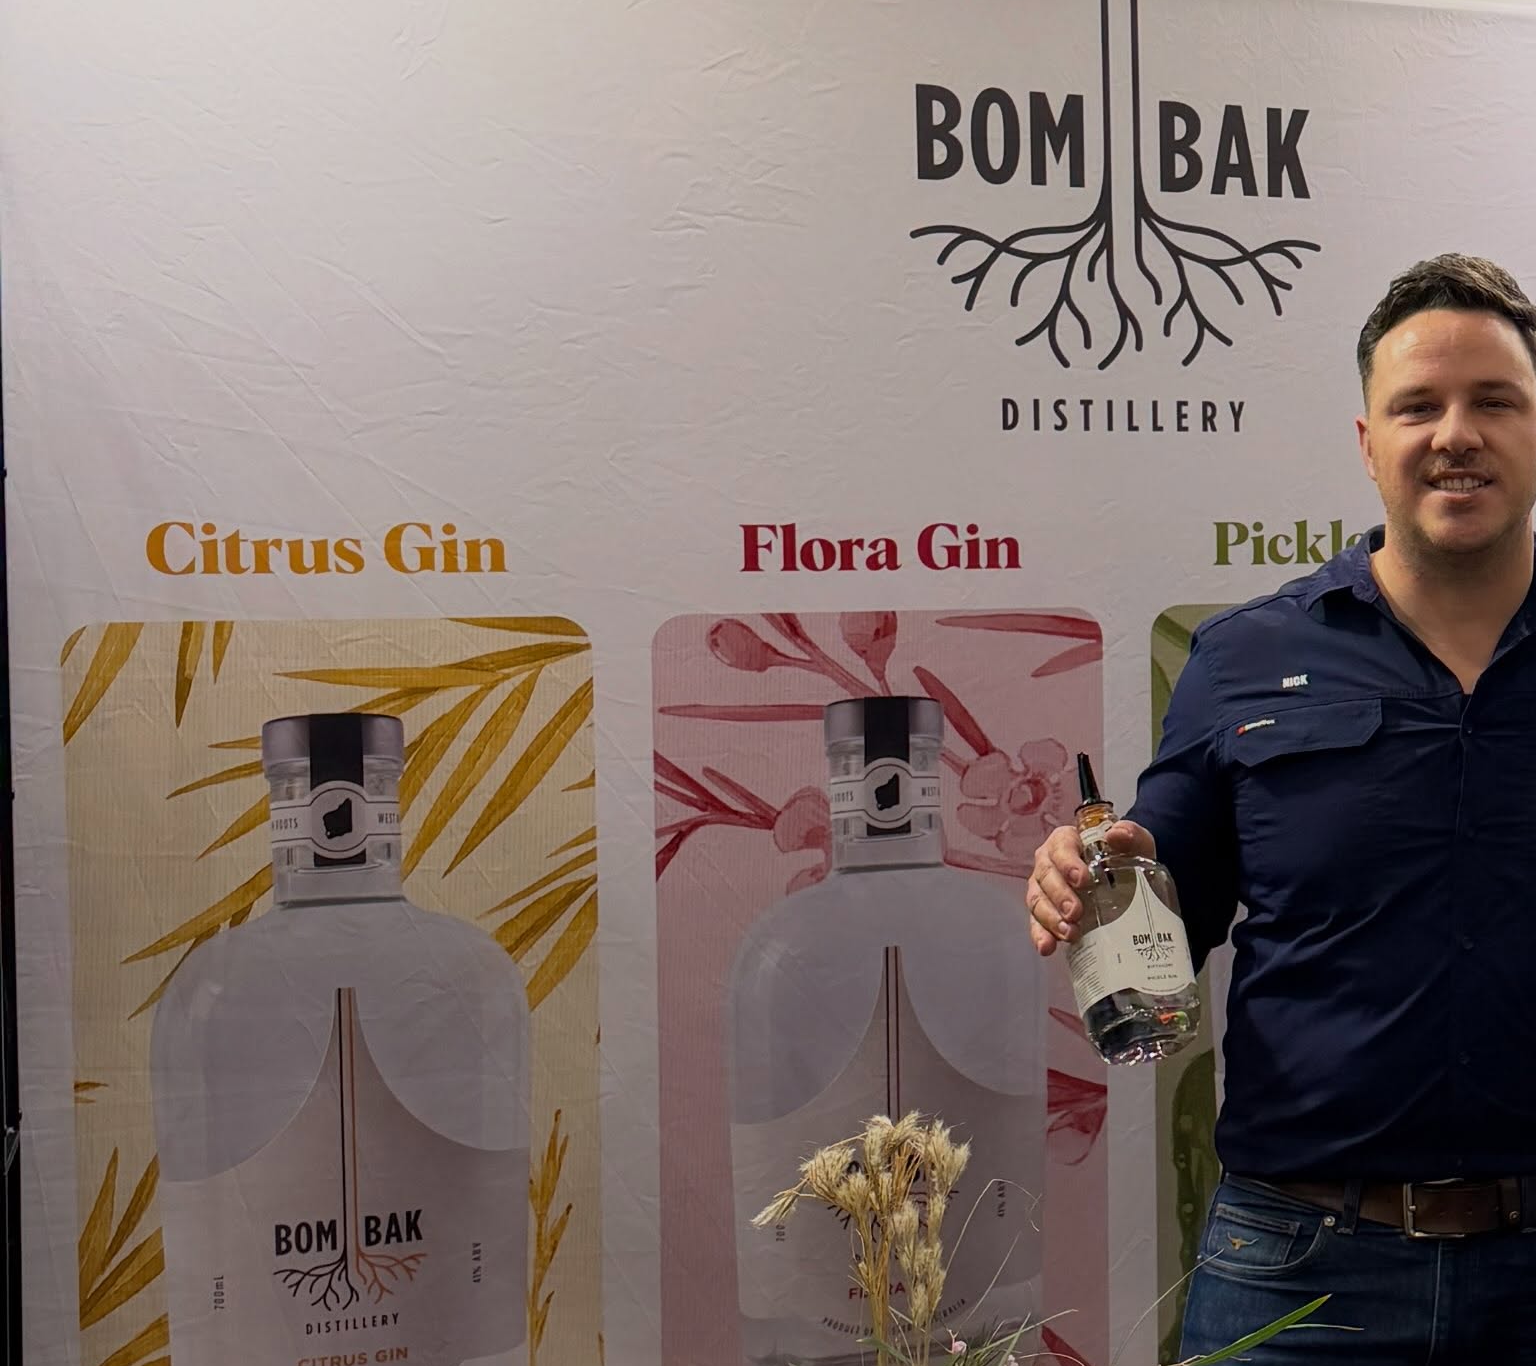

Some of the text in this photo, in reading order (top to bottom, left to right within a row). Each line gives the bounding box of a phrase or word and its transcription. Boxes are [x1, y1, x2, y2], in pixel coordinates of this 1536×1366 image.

[914, 83, 1311, 199] BOM BAK
[1001, 398, 1246, 434] DISTILLERY
[145, 520, 510, 577] Citrus Gin
[739, 522, 1023, 573] Flora Gin
[1282, 674, 1309, 689] NICK
[274, 1209, 423, 1257] BOM BAK
[305, 1312, 401, 1336] DISTILLERY
[375, 1346, 409, 1364] GIN
